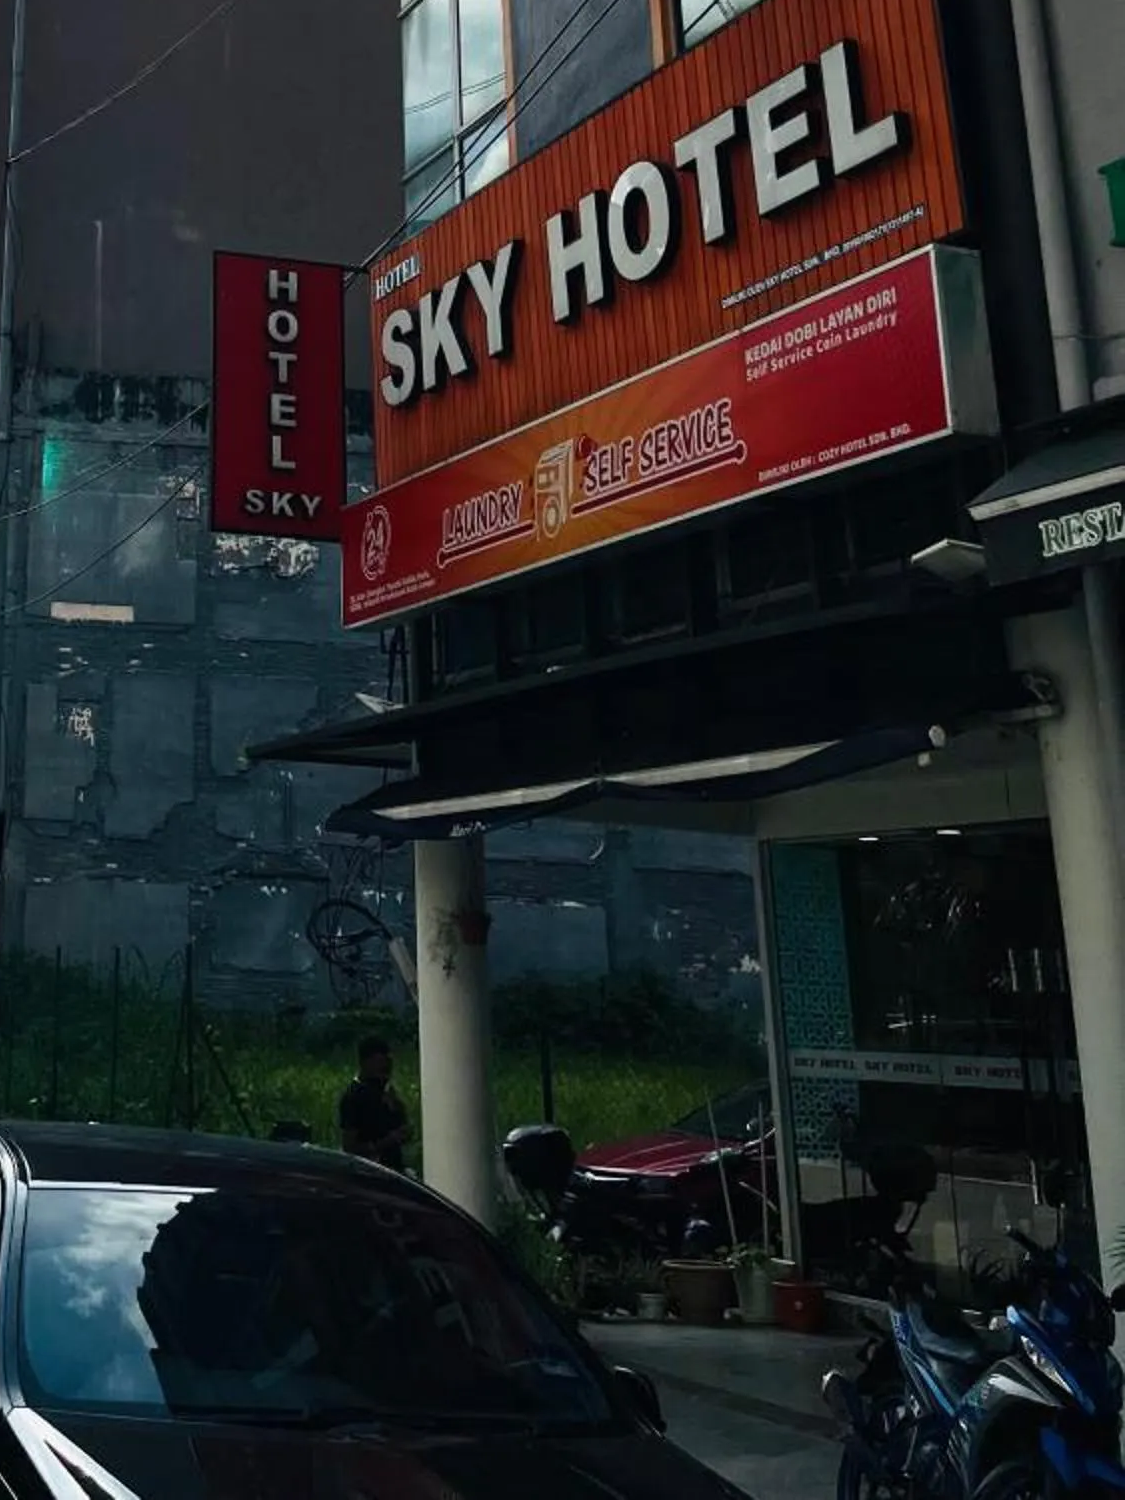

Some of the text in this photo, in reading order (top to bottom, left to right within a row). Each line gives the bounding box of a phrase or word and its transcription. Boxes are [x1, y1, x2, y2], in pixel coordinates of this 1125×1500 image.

[380, 40, 905, 406] SKY HOTEL
[375, 256, 421, 299] HOTEL
[744, 286, 898, 366] KEDAI DOBI LAYAN DIRI
[746, 310, 898, 382] Self Service Coin Laundry
[267, 271, 299, 470] HOTEL
[584, 397, 734, 493] SELF SERVICE
[818, 446, 840, 463] COZY
[840, 439, 867, 455] HOTEL
[245, 490, 322, 520] SKY
[366, 518, 384, 553] 24
[442, 480, 523, 551] LAUNDRY
[1038, 501, 1125, 557] REST
